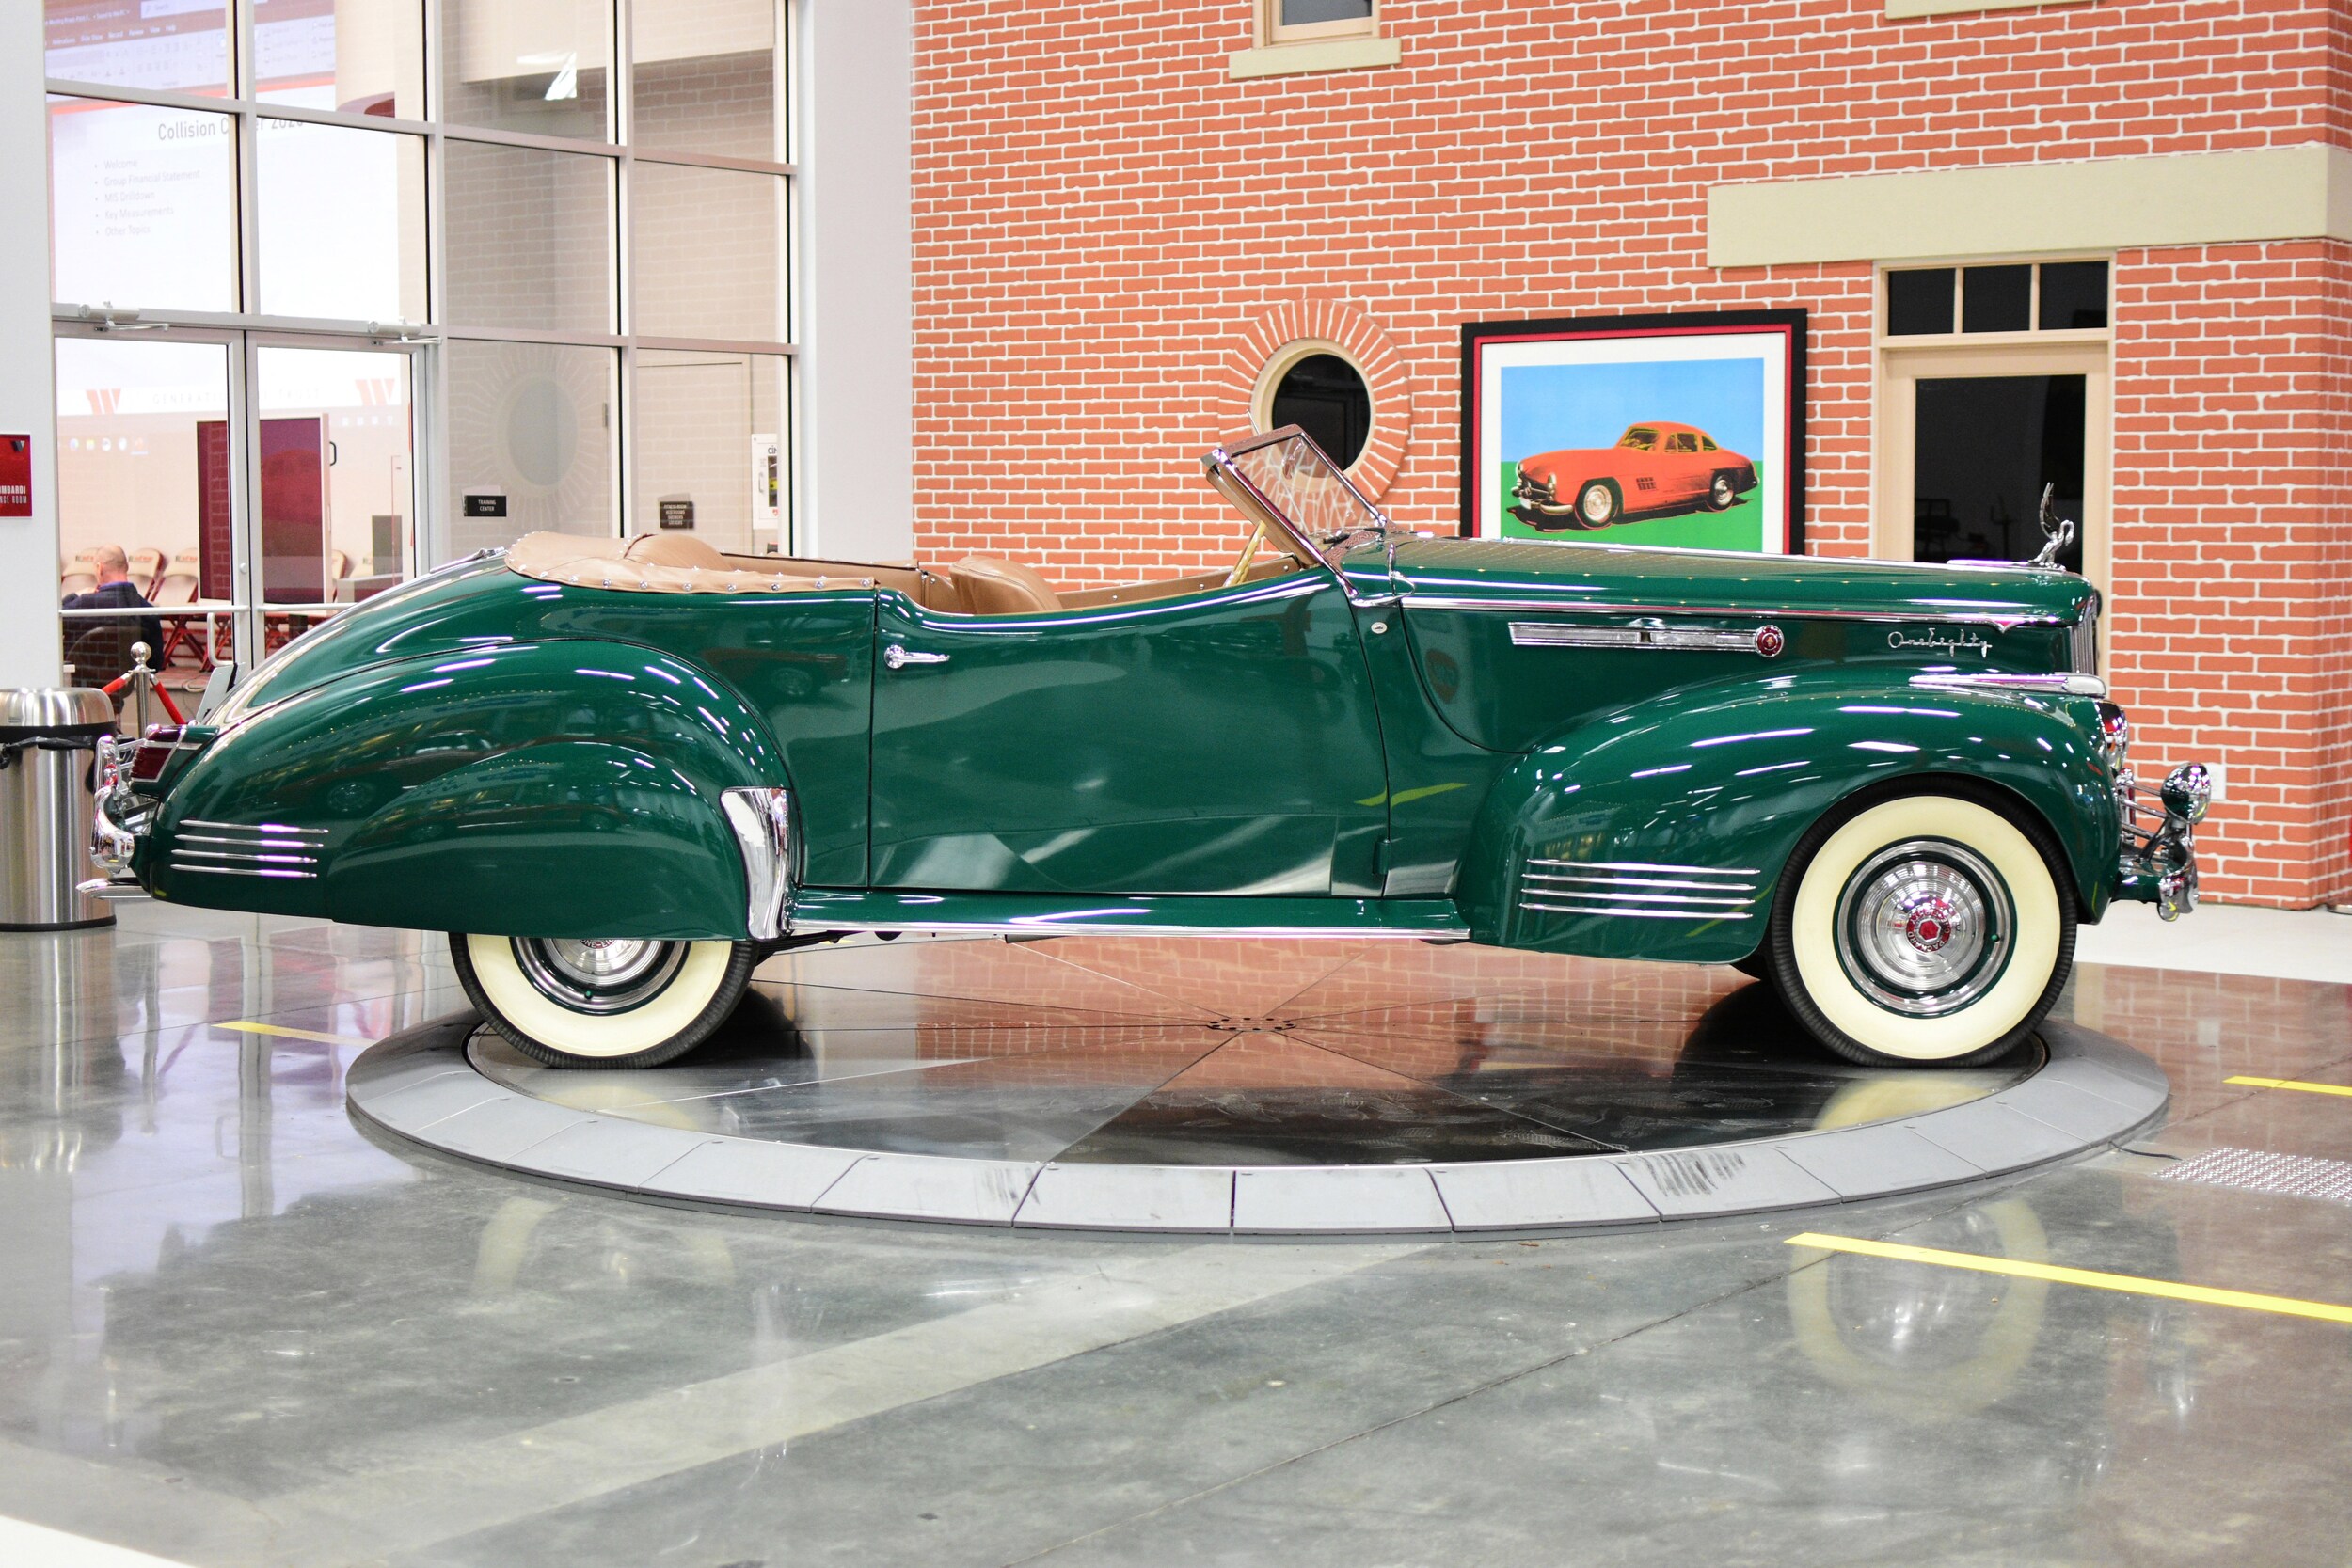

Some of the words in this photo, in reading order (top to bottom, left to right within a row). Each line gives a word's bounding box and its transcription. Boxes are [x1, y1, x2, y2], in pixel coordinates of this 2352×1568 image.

[158, 120, 215, 140] Collision
[103, 159, 137, 169] Welcome
[103, 176, 127, 187] Group
[128, 173, 161, 183] Financial
[162, 170, 200, 182] Statement
[104, 210, 118, 220] Key
[119, 206, 174, 218] Measurements
[104, 226, 126, 236] Other
[128, 224, 151, 235] Topics
[0, 485, 25, 495] MBARDI
[1907, 931, 1946, 952] PACKARD
